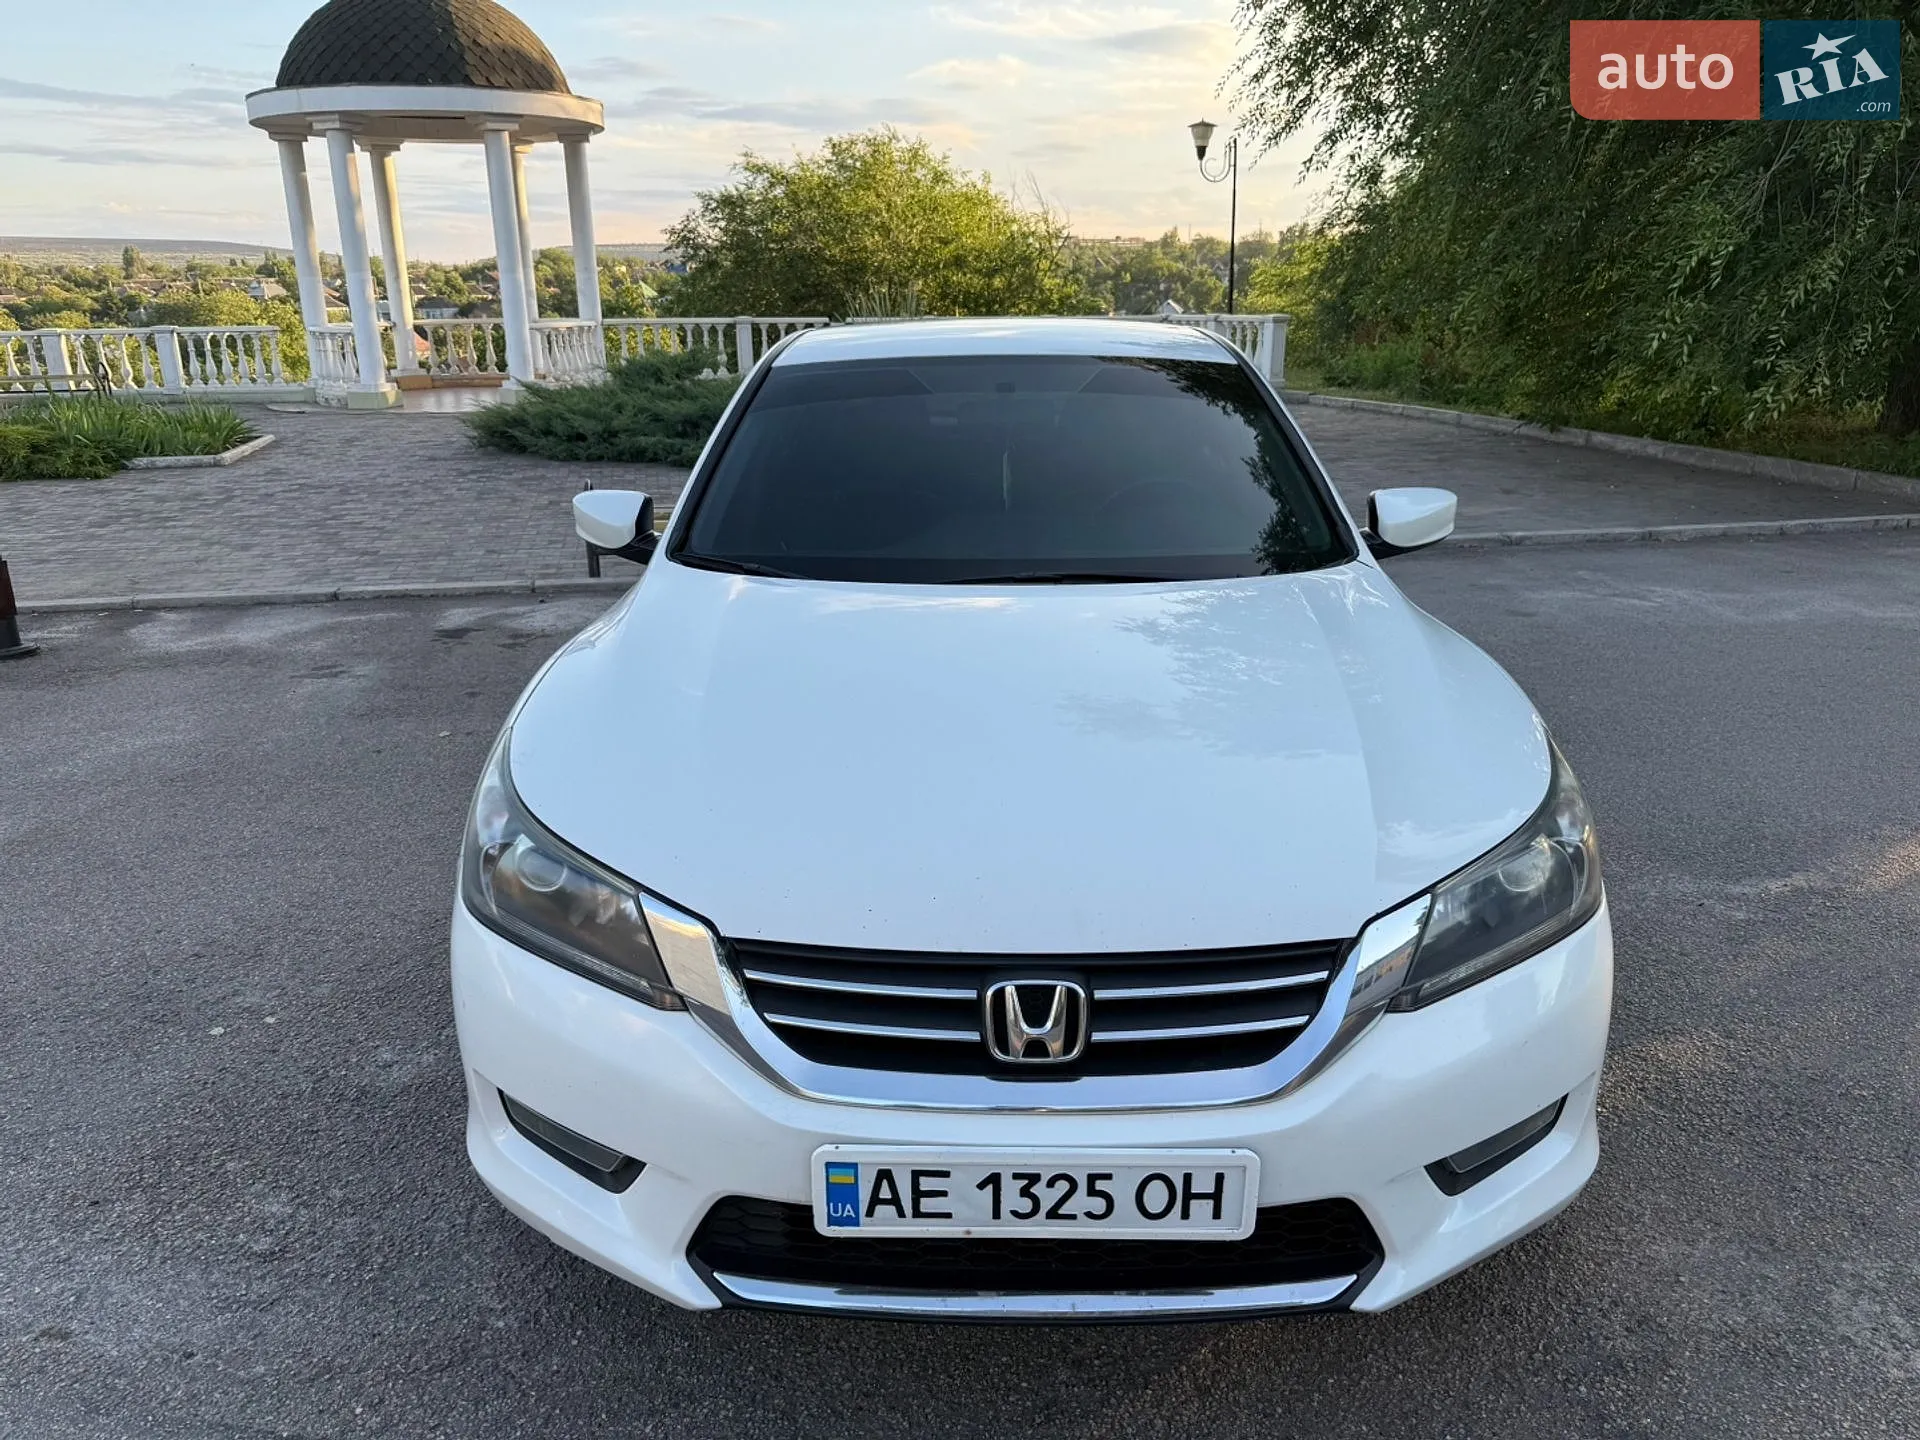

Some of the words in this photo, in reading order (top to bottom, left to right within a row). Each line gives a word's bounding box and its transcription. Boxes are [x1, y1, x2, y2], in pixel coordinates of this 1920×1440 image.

[829, 1202, 857, 1219] UA
[865, 1168, 952, 1220] AE
[976, 1171, 1115, 1221] 1325
[1134, 1172, 1225, 1221] OH
